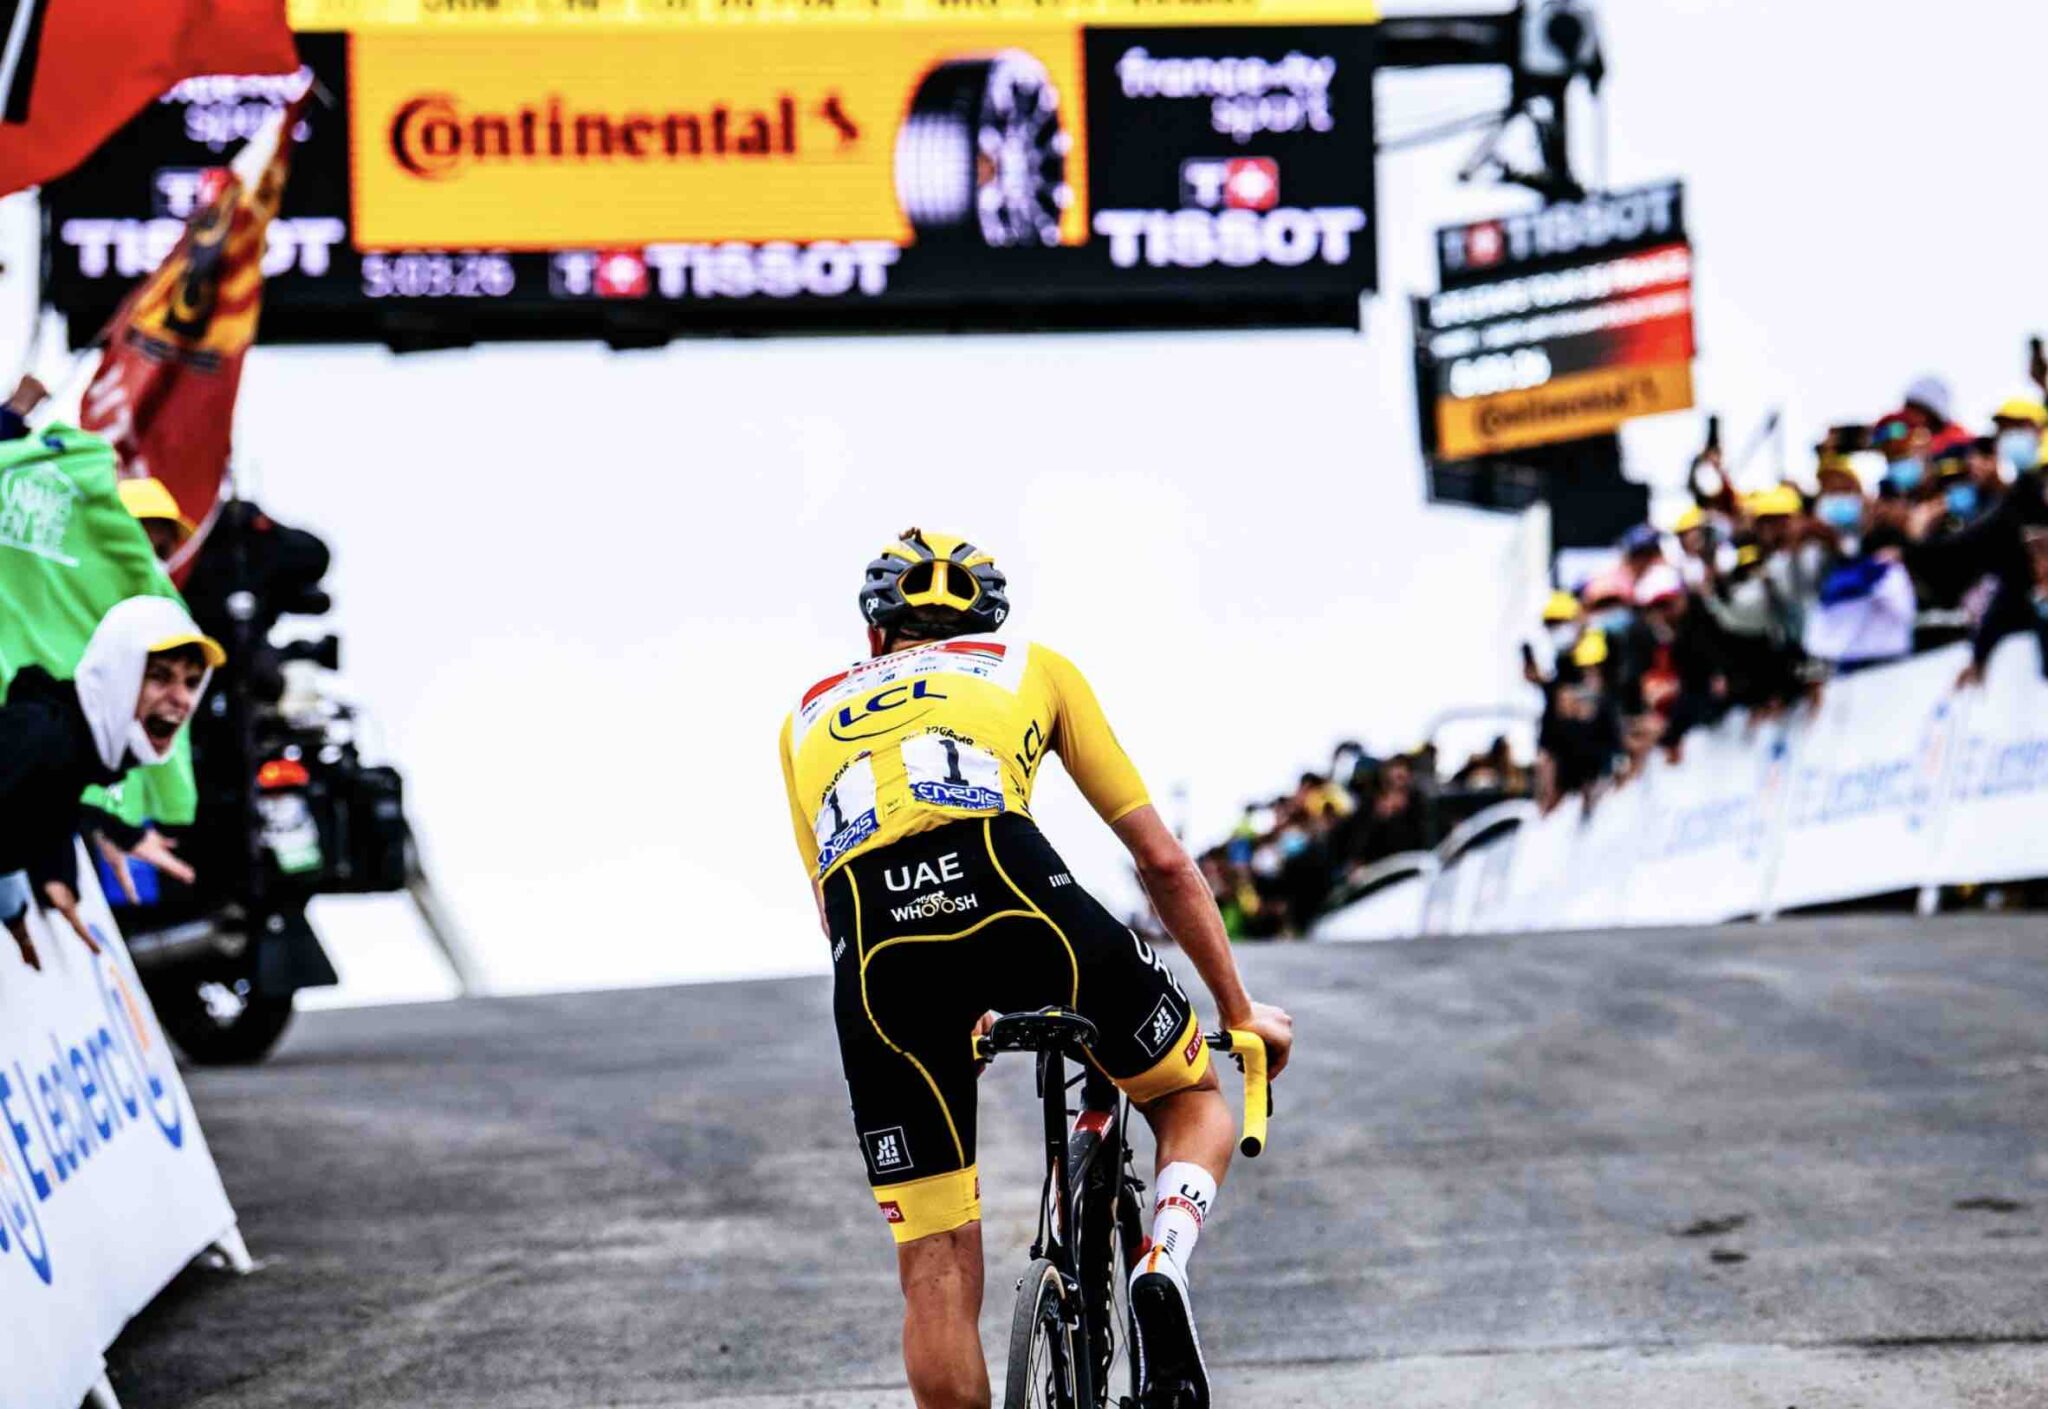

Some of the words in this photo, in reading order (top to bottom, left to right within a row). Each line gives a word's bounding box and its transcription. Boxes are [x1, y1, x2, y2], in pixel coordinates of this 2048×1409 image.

[389, 92, 797, 180] Continental
[1093, 206, 1367, 267] TISSOT
[1502, 186, 1673, 261] TISSOT
[642, 242, 899, 297] TISSOT
[838, 680, 948, 729] LCL
[938, 739, 969, 787] 1
[1015, 718, 1046, 779] LCL
[827, 787, 850, 839] 1
[884, 851, 965, 893] UAE
[890, 892, 979, 923] WHOOSH
[0, 1027, 139, 1203] E.Leclerc
